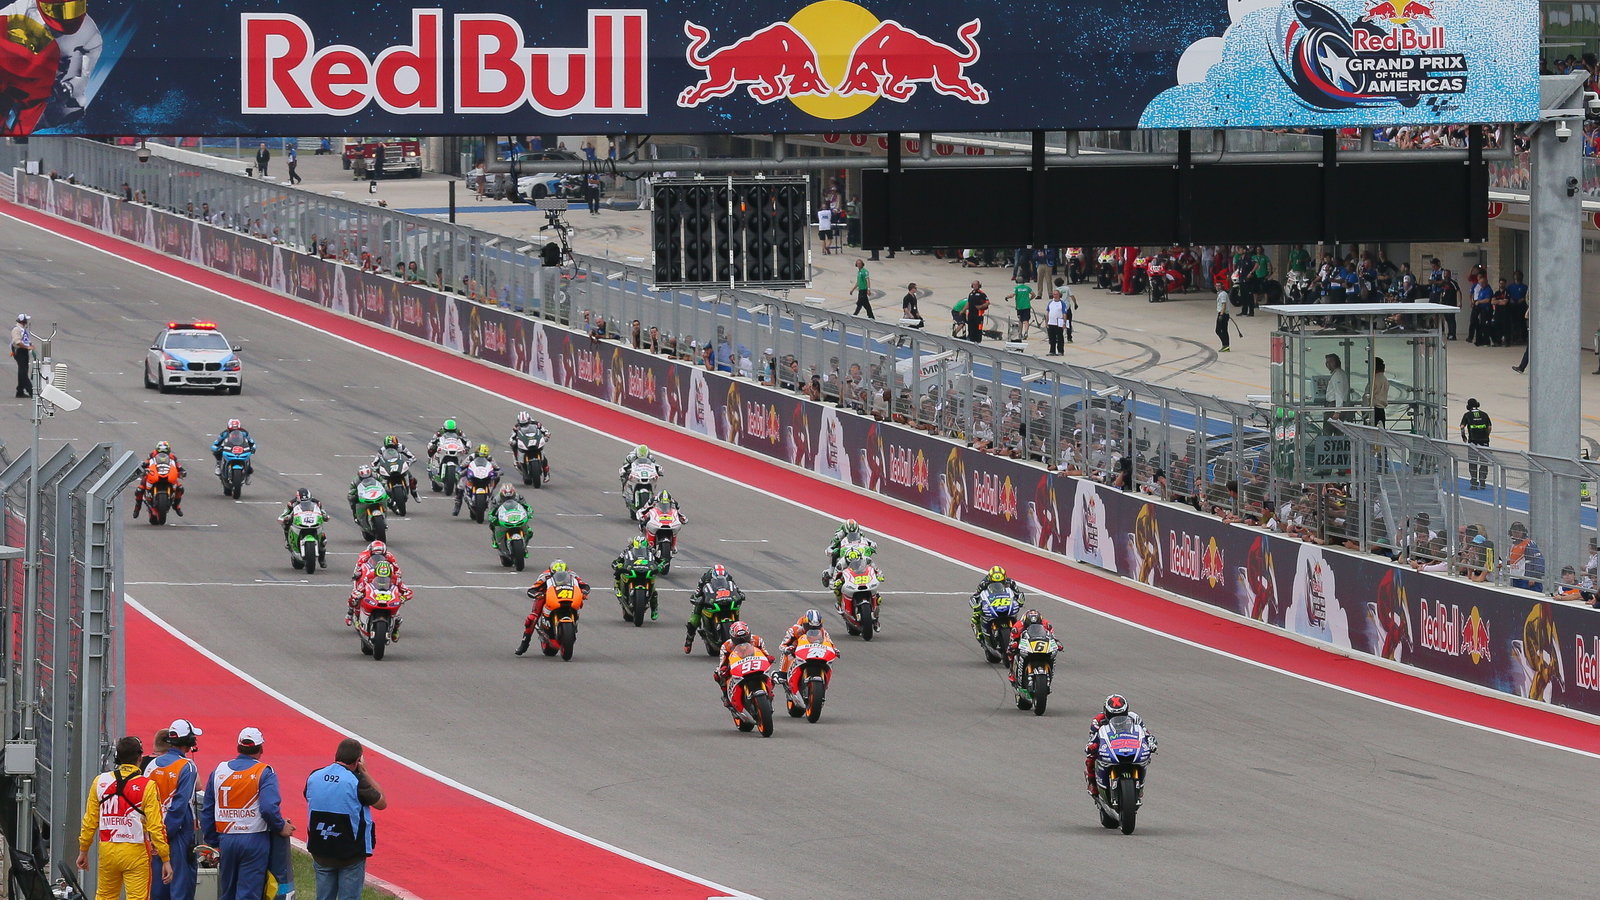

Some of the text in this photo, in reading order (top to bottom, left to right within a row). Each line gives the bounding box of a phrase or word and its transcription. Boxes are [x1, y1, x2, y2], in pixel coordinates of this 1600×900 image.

[1352, 26, 1445, 51] Red Bull
[241, 8, 647, 116] Red Bull
[1348, 56, 1463, 71] GRAND PRIX
[1375, 71, 1388, 79] OF
[1367, 78, 1463, 92] AMERICAS
[911, 140, 919, 149] 10
[942, 144, 949, 153] 11
[1324, 440, 1350, 451] STAR
[889, 444, 911, 487] Red Bull
[1317, 454, 1351, 465] DELAY
[973, 469, 998, 516] Red Bull
[1170, 530, 1200, 580] Red Bull
[557, 590, 573, 598] 41
[989, 598, 1010, 606] 46
[1420, 598, 1459, 656] Red Bull
[1034, 642, 1046, 651] 6
[741, 660, 761, 674] 93
[1575, 634, 1599, 691] Red
[324, 775, 340, 783] 092
[220, 786, 231, 807] T
[219, 809, 256, 818] AMERICAS
